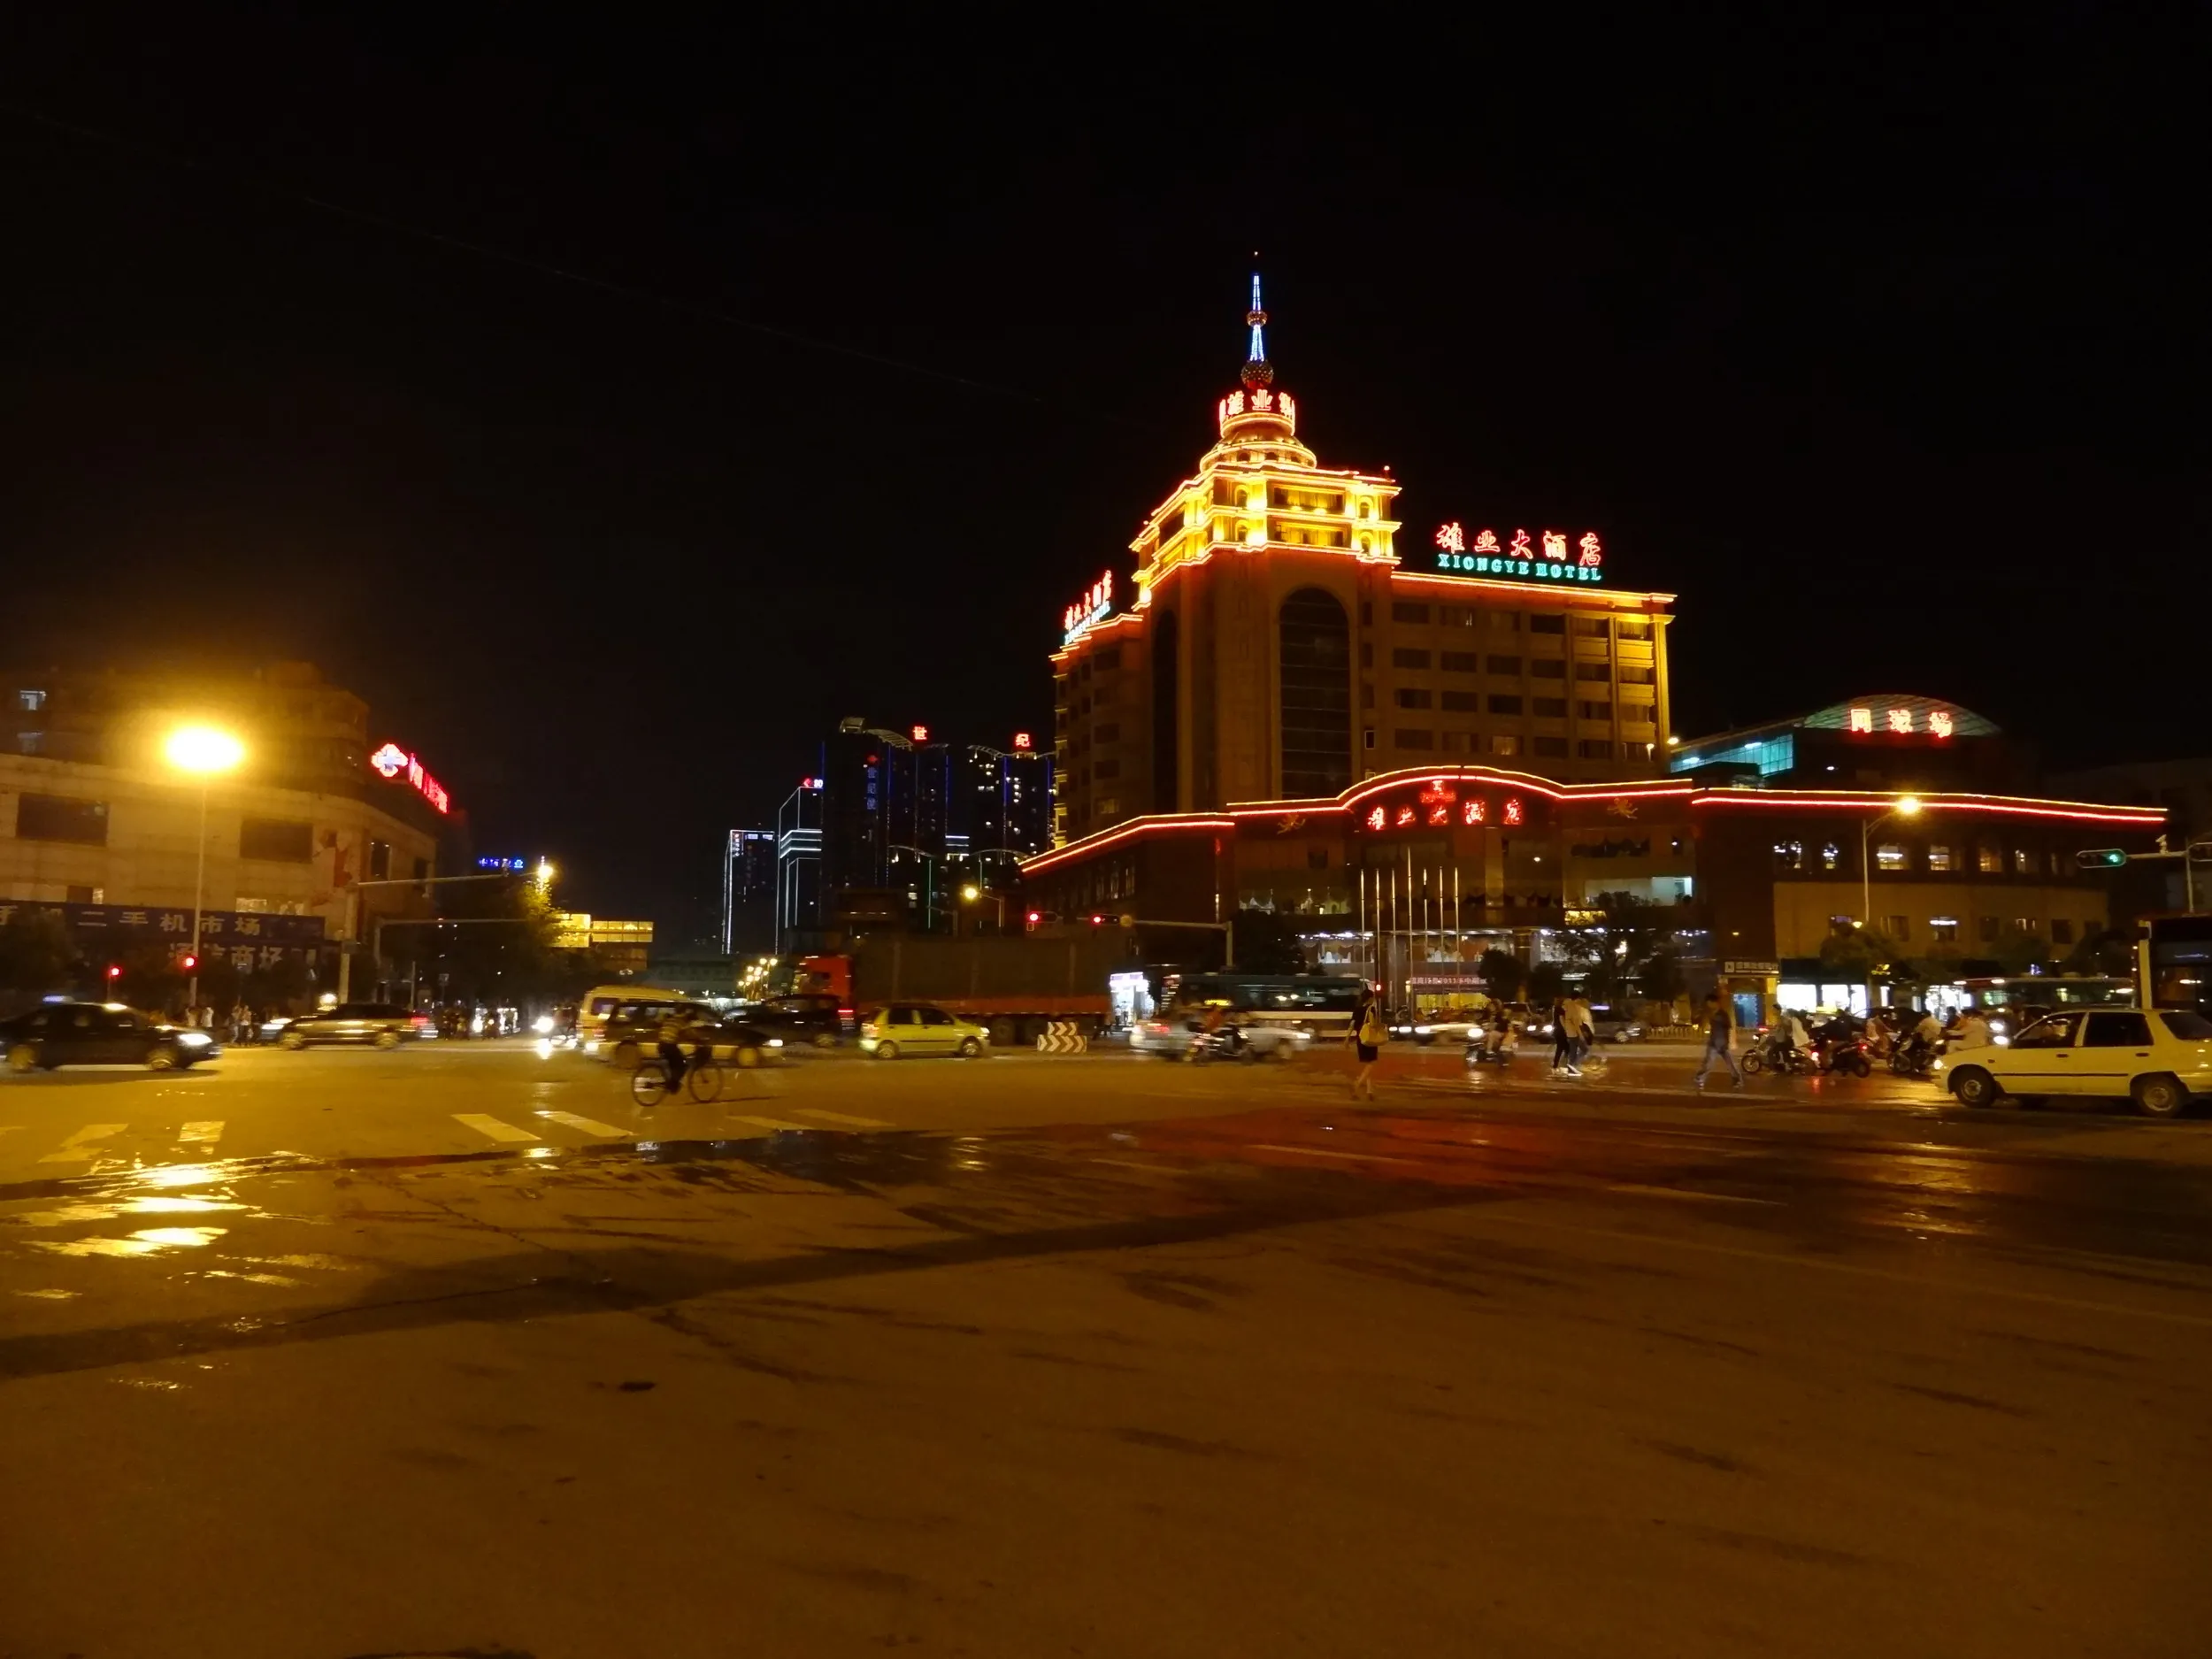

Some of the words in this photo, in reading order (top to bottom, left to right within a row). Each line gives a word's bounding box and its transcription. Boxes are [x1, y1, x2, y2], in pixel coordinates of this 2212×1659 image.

[1436, 522, 1601, 566] 雄业大酒店
[1438, 554, 1529, 575] XIONGYE
[1536, 563, 1601, 581] HOTEL
